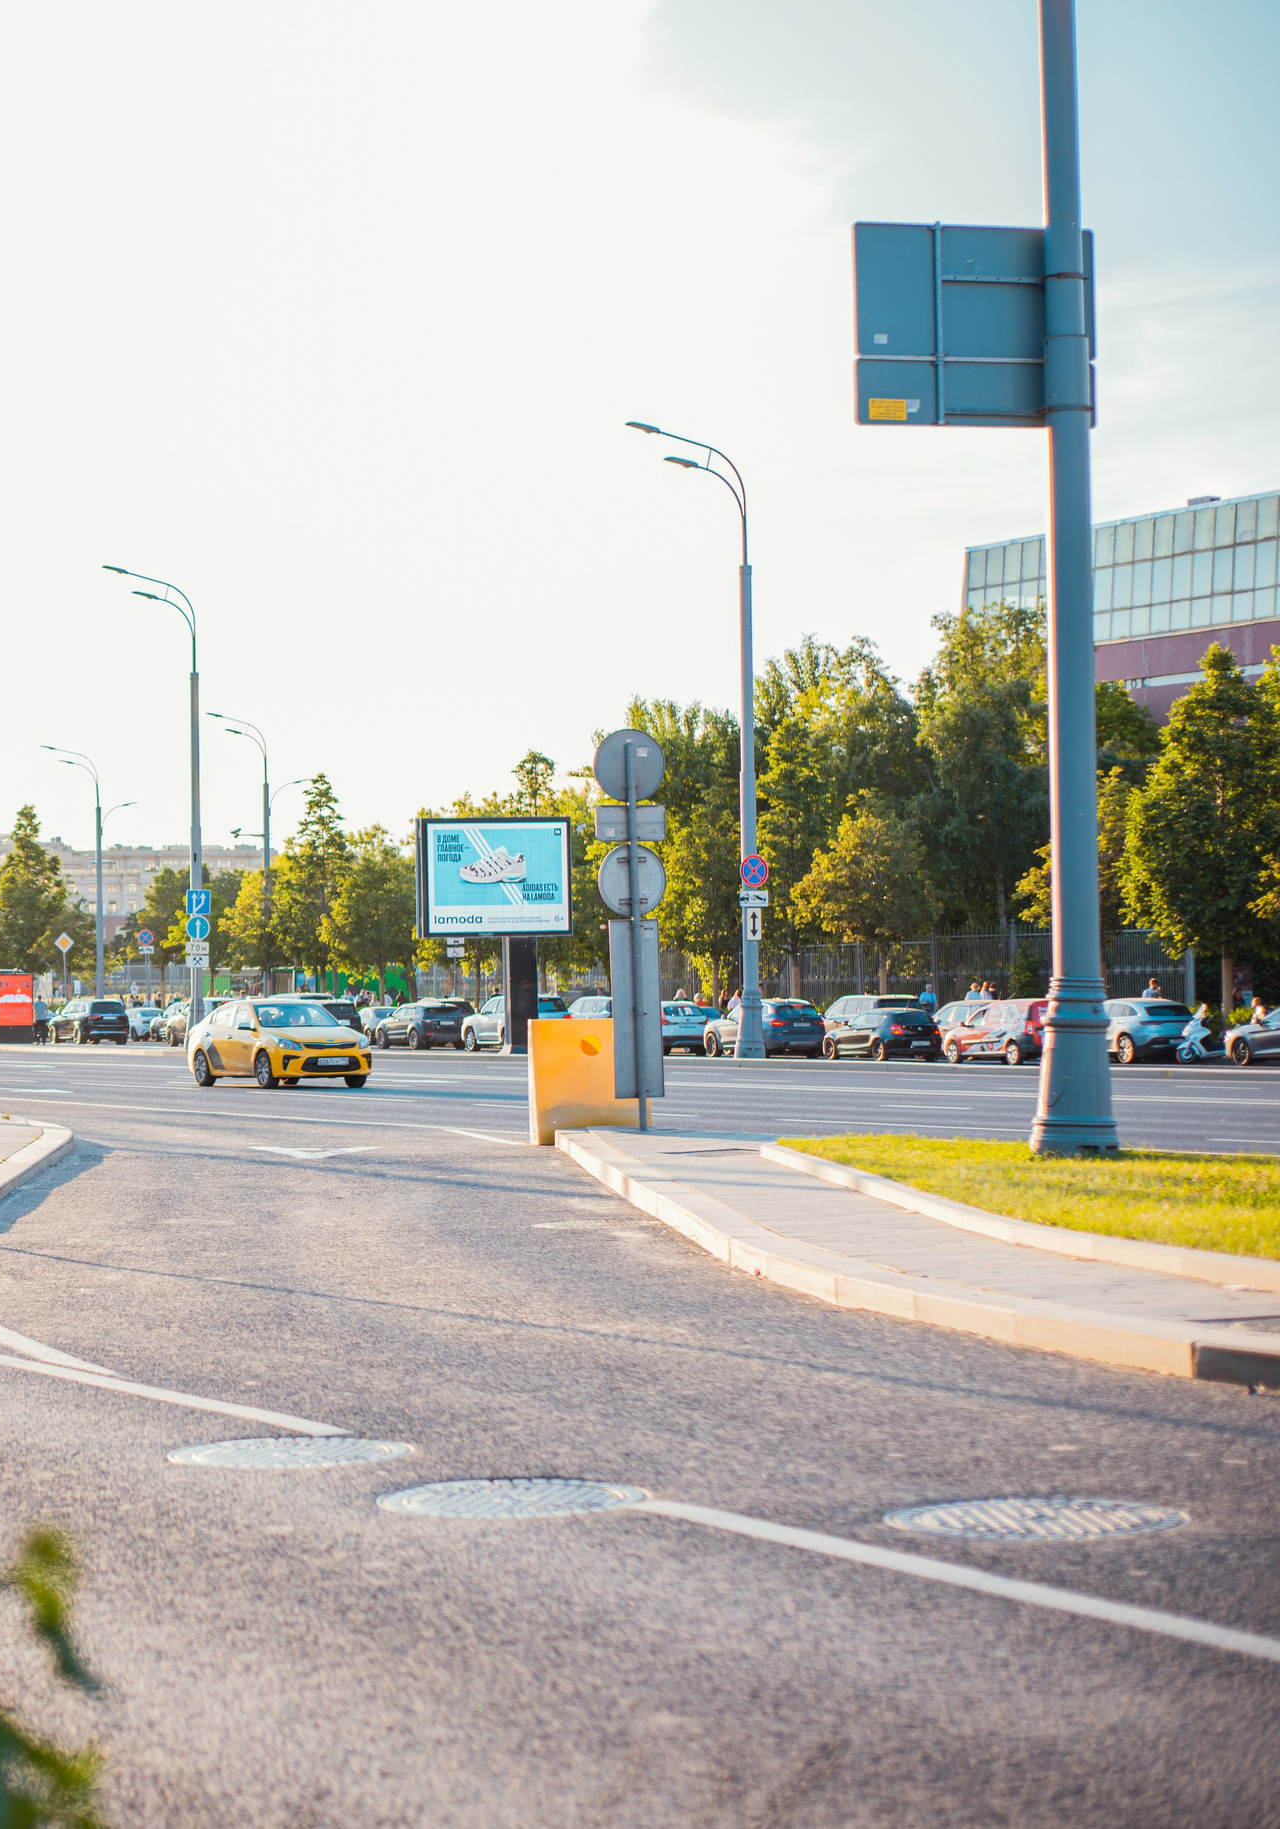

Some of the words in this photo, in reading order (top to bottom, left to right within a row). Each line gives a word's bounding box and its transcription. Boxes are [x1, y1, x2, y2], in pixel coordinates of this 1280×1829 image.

[437, 834, 442, 843] В
[442, 834, 460, 844] ДОМЕ
[437, 844, 464, 852] ГЛАВНОЕ
[437, 853, 462, 863] ПОГОДА
[543, 883, 559, 892] ЕСТЬ
[531, 892, 555, 901] LAMODA
[434, 915, 483, 924] lamoda
